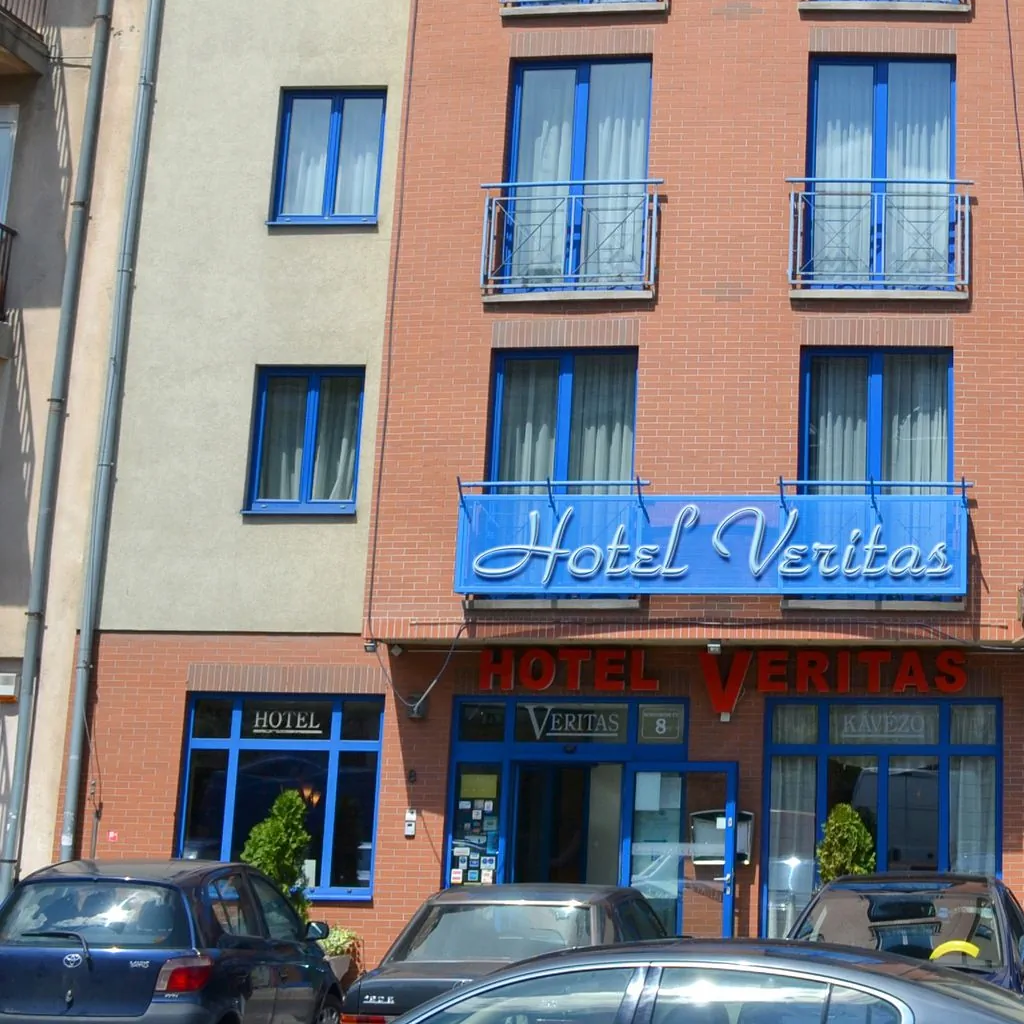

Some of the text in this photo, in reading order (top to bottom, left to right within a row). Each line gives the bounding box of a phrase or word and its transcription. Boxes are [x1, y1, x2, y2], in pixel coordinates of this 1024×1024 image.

[473, 504, 953, 586] Hotel Veritas
[479, 649, 969, 714] HOTEL VERITAS
[254, 710, 320, 728] HOTEL
[524, 704, 619, 740] VERITAS
[655, 718, 666, 734] 8
